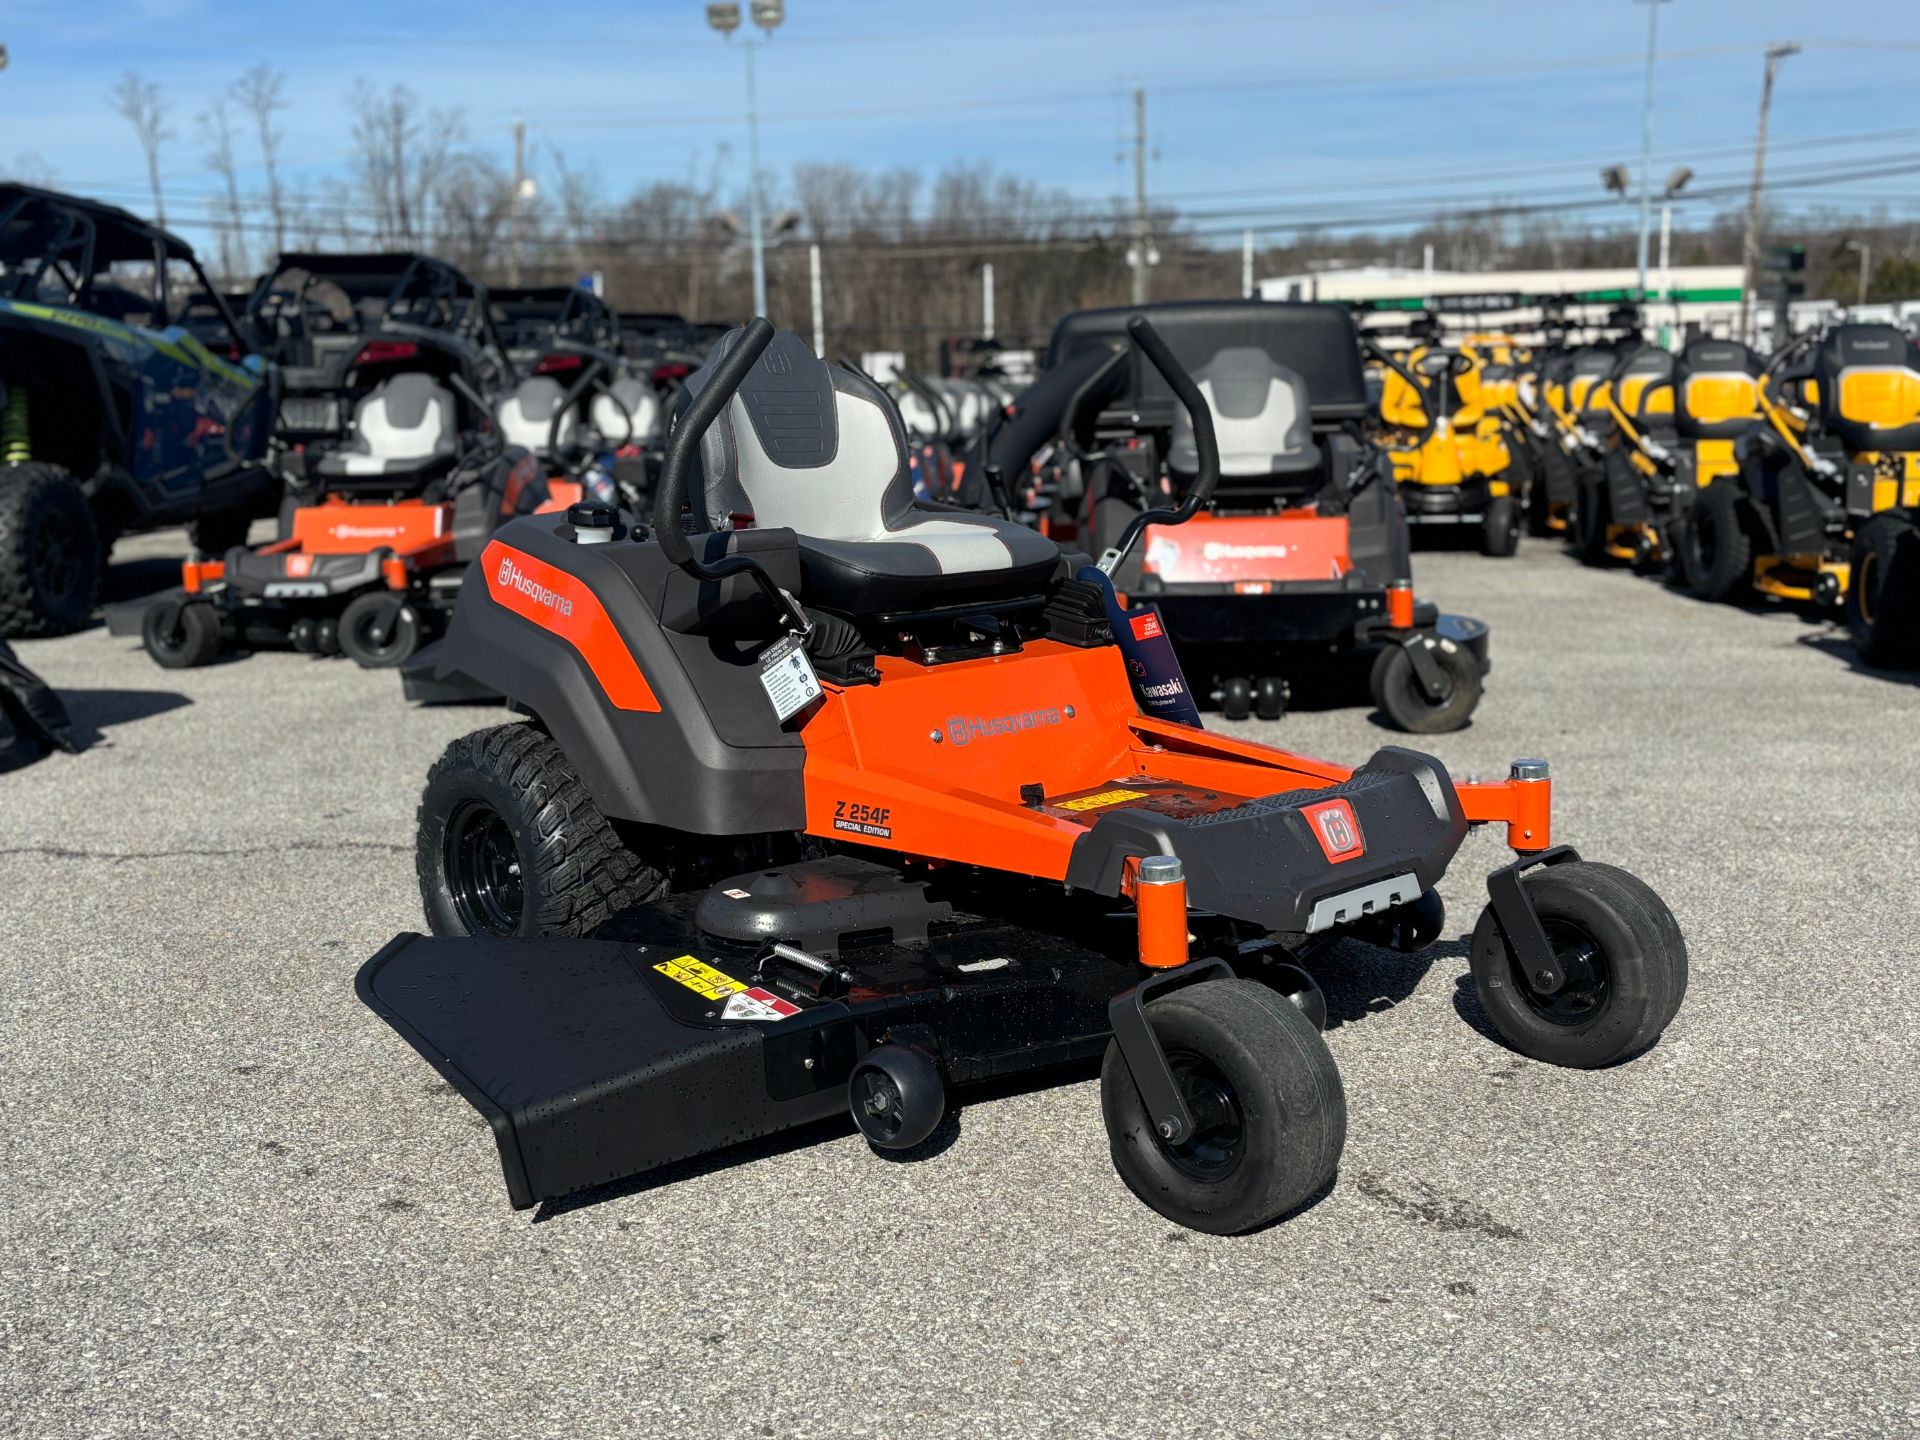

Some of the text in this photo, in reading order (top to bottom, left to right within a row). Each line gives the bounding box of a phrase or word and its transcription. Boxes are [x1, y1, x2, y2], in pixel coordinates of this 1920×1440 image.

[510, 566, 573, 617] Husqvarna
[1140, 677, 1184, 698] Kawasaki
[967, 707, 1061, 739] Husqvarna
[835, 800, 891, 825] Z 254F
[835, 820, 890, 837] SPECIAL EDITION
